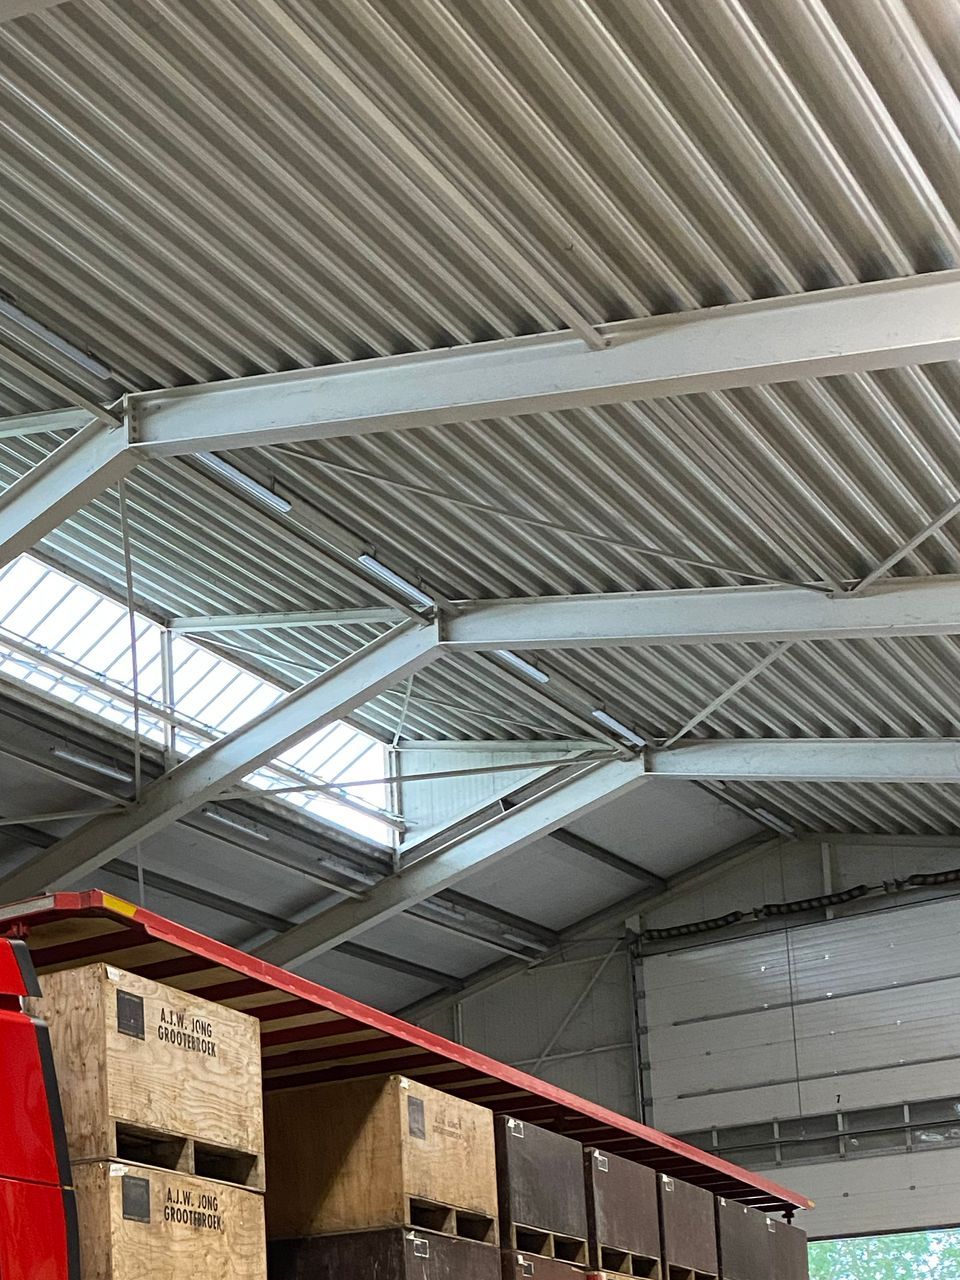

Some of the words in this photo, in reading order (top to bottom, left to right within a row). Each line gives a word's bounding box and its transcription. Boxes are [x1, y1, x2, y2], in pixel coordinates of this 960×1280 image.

[160, 1008, 187, 1030] A.J.W.
[191, 1017, 213, 1038] JONG
[157, 1026, 217, 1057] GROOTEBROEK
[167, 1187, 195, 1208] A.J.W.
[197, 1194, 218, 1212] JONG
[164, 1205, 222, 1231] GROOTEBROEK
